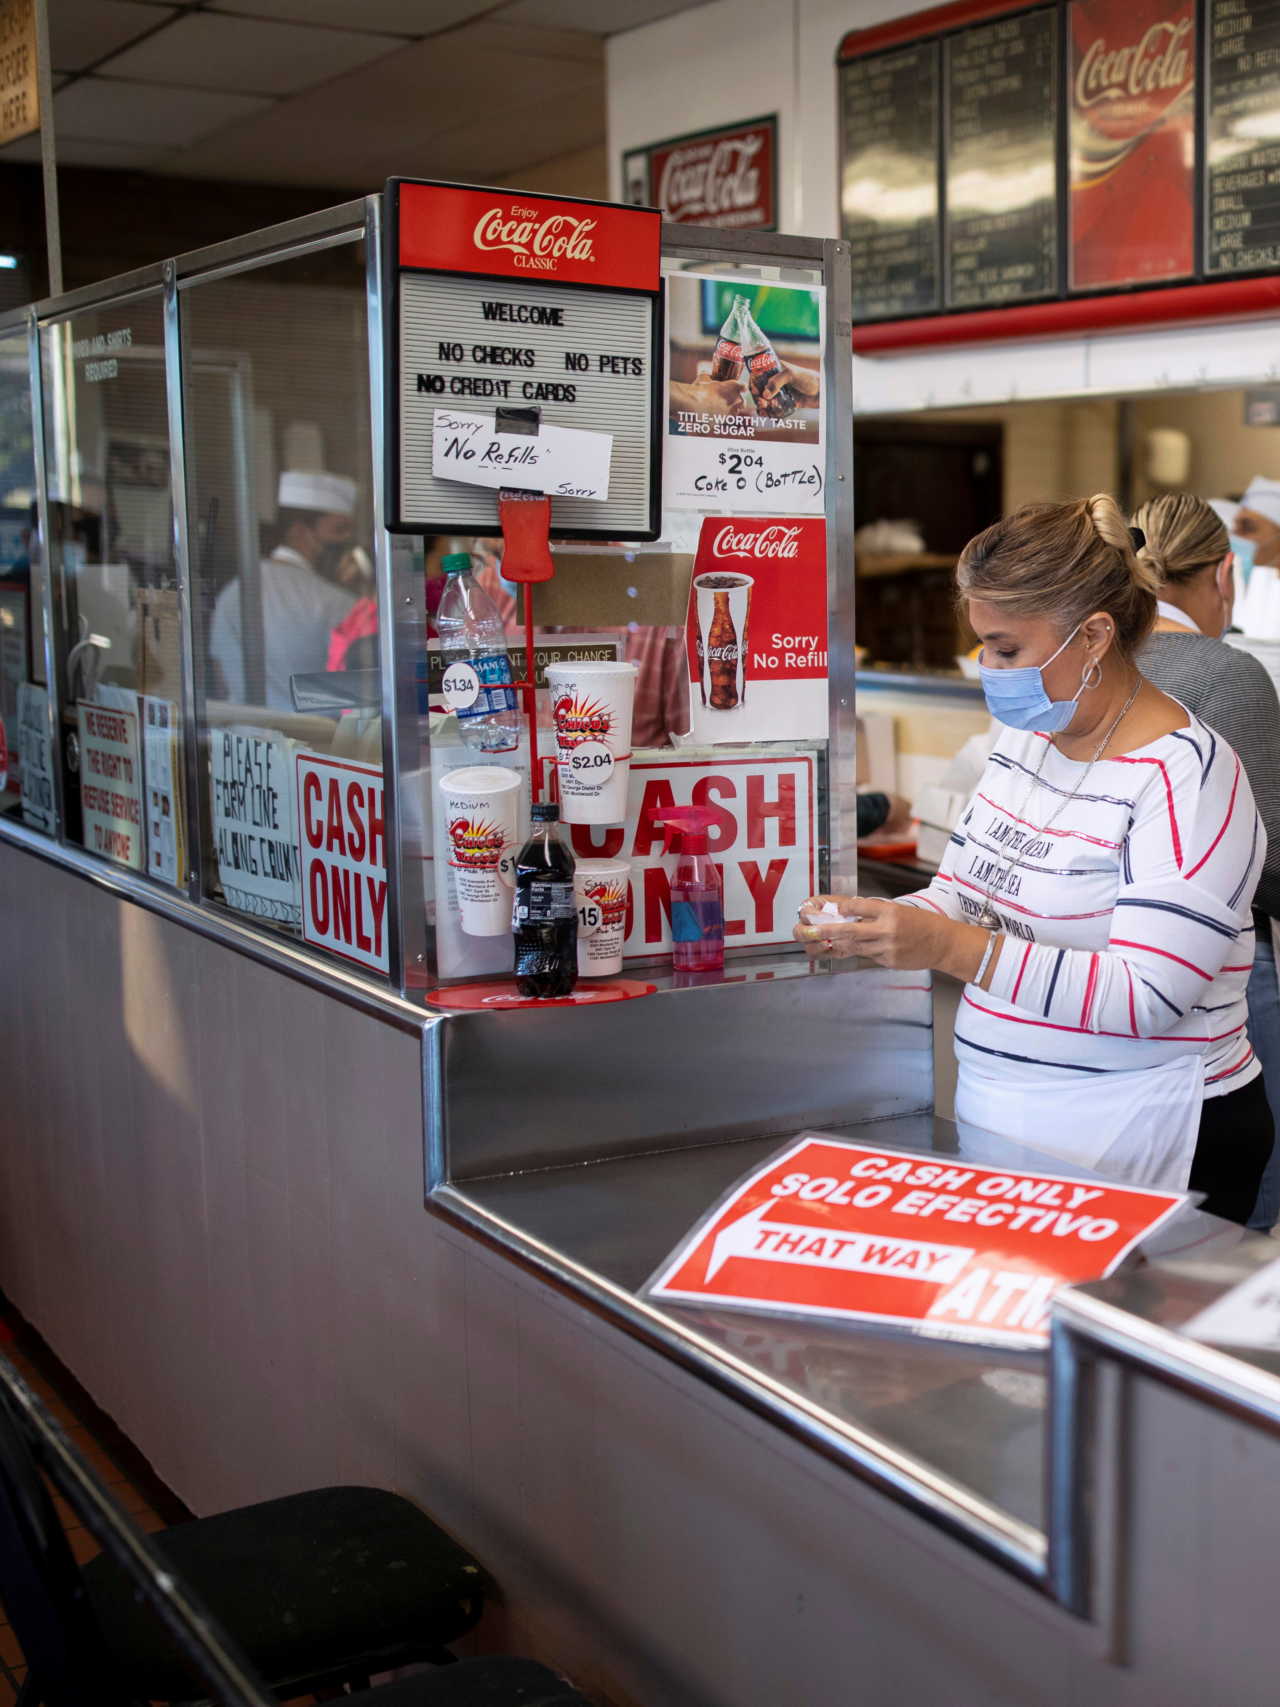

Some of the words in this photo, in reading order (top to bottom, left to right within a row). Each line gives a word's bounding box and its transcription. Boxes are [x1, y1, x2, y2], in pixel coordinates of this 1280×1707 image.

[510, 205, 538, 220] Enjoy
[513, 255, 558, 272] CLASSIC
[481, 300, 565, 328] WELCOME
[438, 341, 465, 364] NO
[471, 344, 535, 369] CHECKS
[564, 351, 590, 373] NO
[599, 353, 643, 377] PETS
[416, 373, 445, 395] NO
[521, 381, 577, 404] CARDS
[434, 412, 485, 436] Sorry
[677, 422, 711, 434] ZERO
[713, 426, 755, 437] SUGAR
[678, 411, 769, 429] TITLE-WORTHY
[771, 418, 807, 431] TASTE
[554, 481, 598, 499] Sorry
[771, 632, 818, 654] Sorry
[567, 649, 613, 662] CHANGE
[754, 652, 781, 669] No
[443, 678, 474, 693] $1.34
[222, 731, 274, 786] PLEASE
[571, 752, 612, 770] $2.04
[251, 783, 280, 831] LINE
[304, 770, 388, 870] CASH
[989, 821, 1012, 843] AM
[974, 859, 996, 882] AM
[1003, 873, 1022, 897] SEA
[309, 857, 388, 959] ONLY
[849, 1157, 975, 1195] CASH
[976, 1177, 1104, 1210] ONLY
[770, 1172, 894, 1208] SOLO
[891, 1190, 1119, 1241] EFECTIVO
[757, 1229, 855, 1261] THAT
[861, 1241, 954, 1273] WAY
